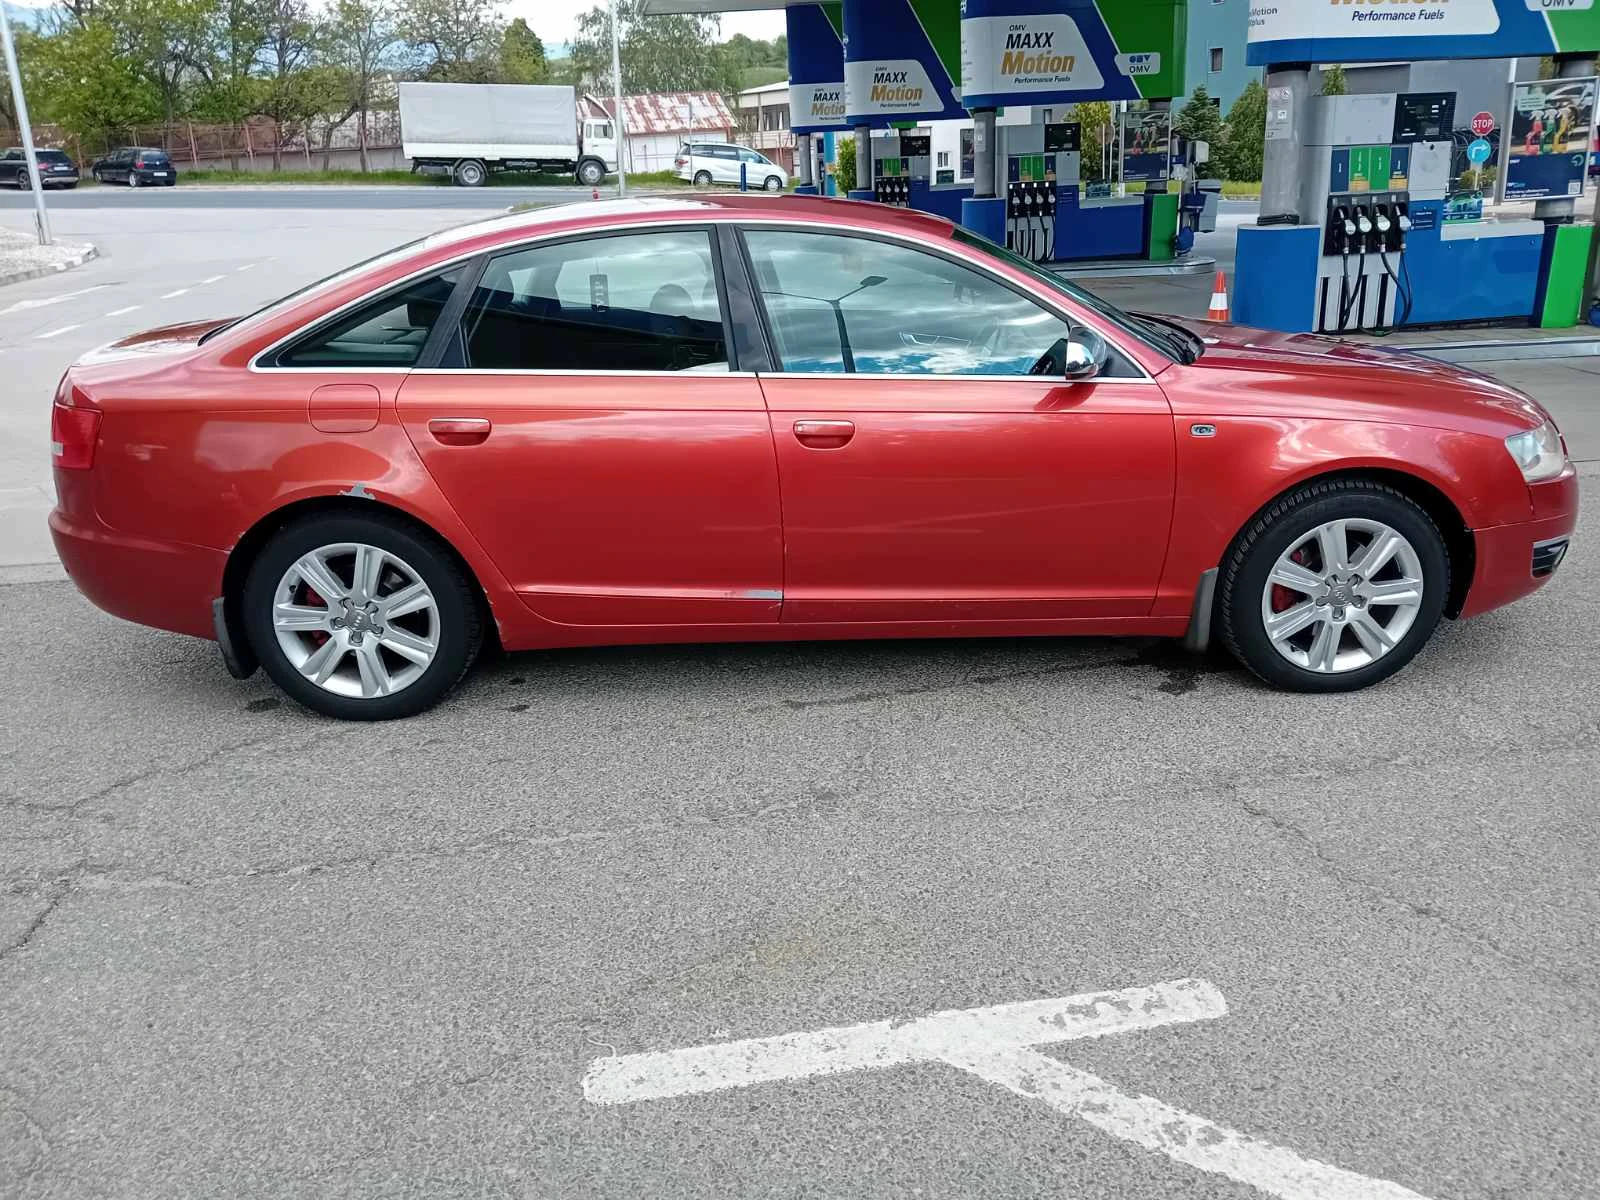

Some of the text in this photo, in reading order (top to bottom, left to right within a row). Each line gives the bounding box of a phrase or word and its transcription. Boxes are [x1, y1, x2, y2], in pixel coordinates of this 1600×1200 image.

[1351, 9, 1445, 21] Performance Fuels
[1009, 24, 1026, 32] OMV
[1005, 32, 1055, 49] MAXX
[1001, 49, 1075, 76] Motion
[1129, 65, 1151, 73] OMV
[873, 71, 907, 84] MAXX
[1014, 76, 1054, 84] Performance
[813, 92, 840, 101] MAXX
[871, 84, 922, 101] Motion
[811, 102, 846, 115] Motio
[1472, 119, 1493, 129] STOP
